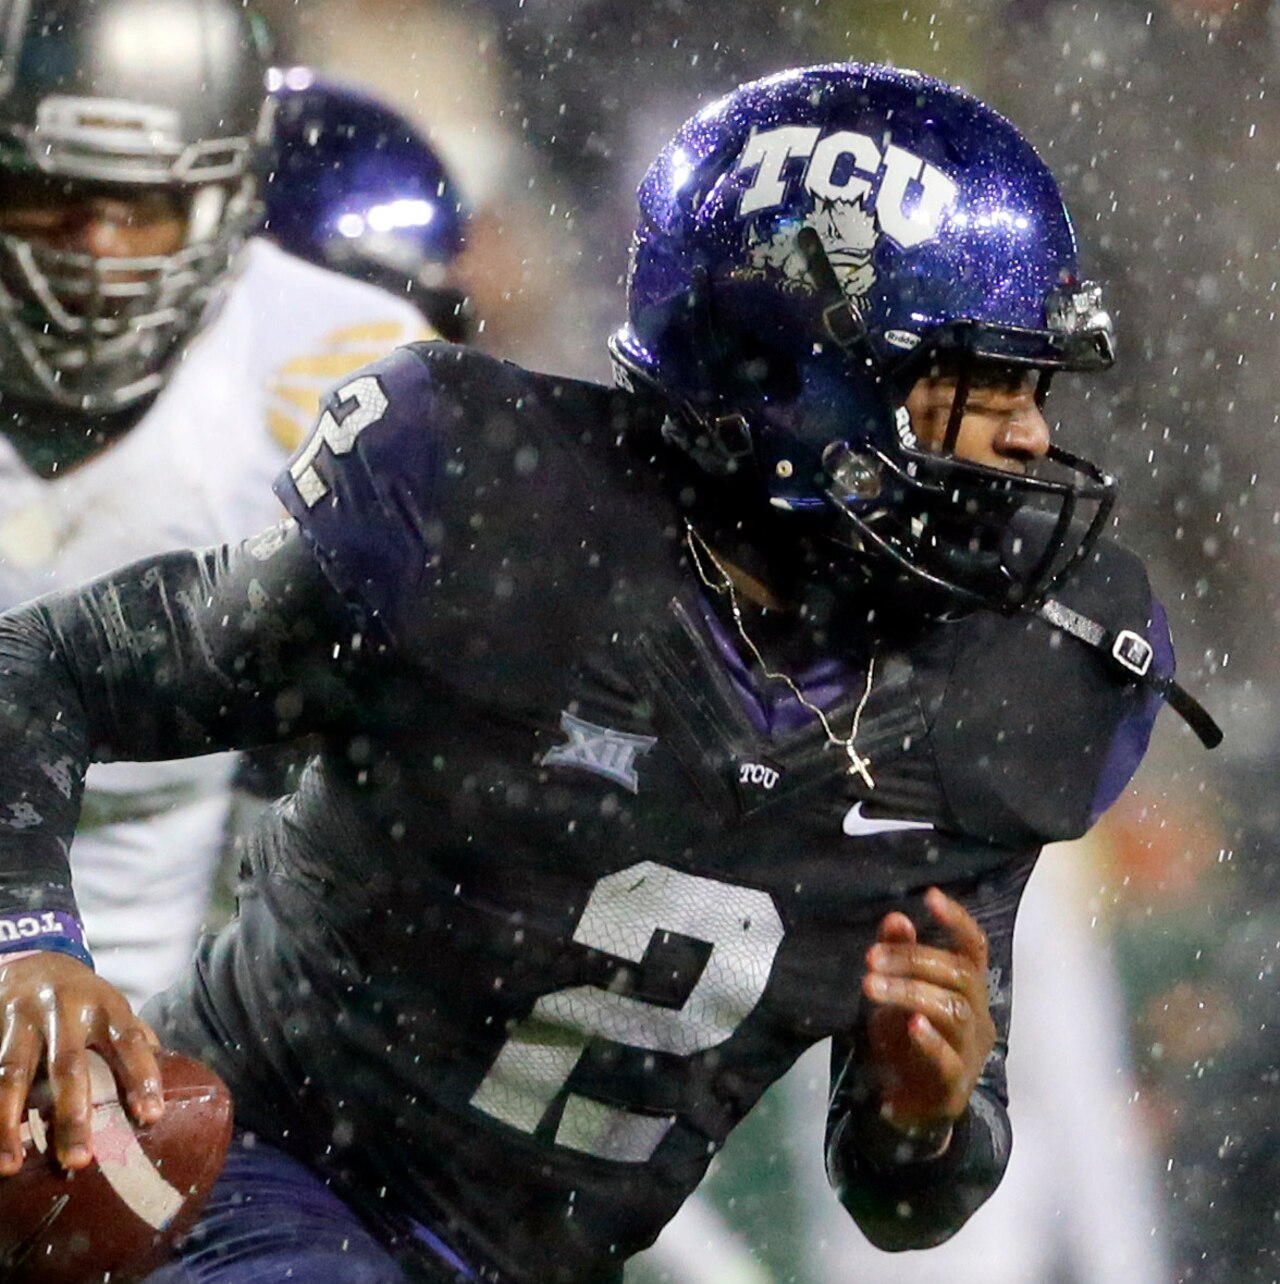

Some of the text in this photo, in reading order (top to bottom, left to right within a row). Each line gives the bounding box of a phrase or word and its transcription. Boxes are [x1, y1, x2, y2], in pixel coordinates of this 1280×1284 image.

[738, 126, 959, 249] TCU
[289, 376, 388, 508] 2
[739, 763, 780, 790] TCU
[469, 860, 786, 1163] 2
